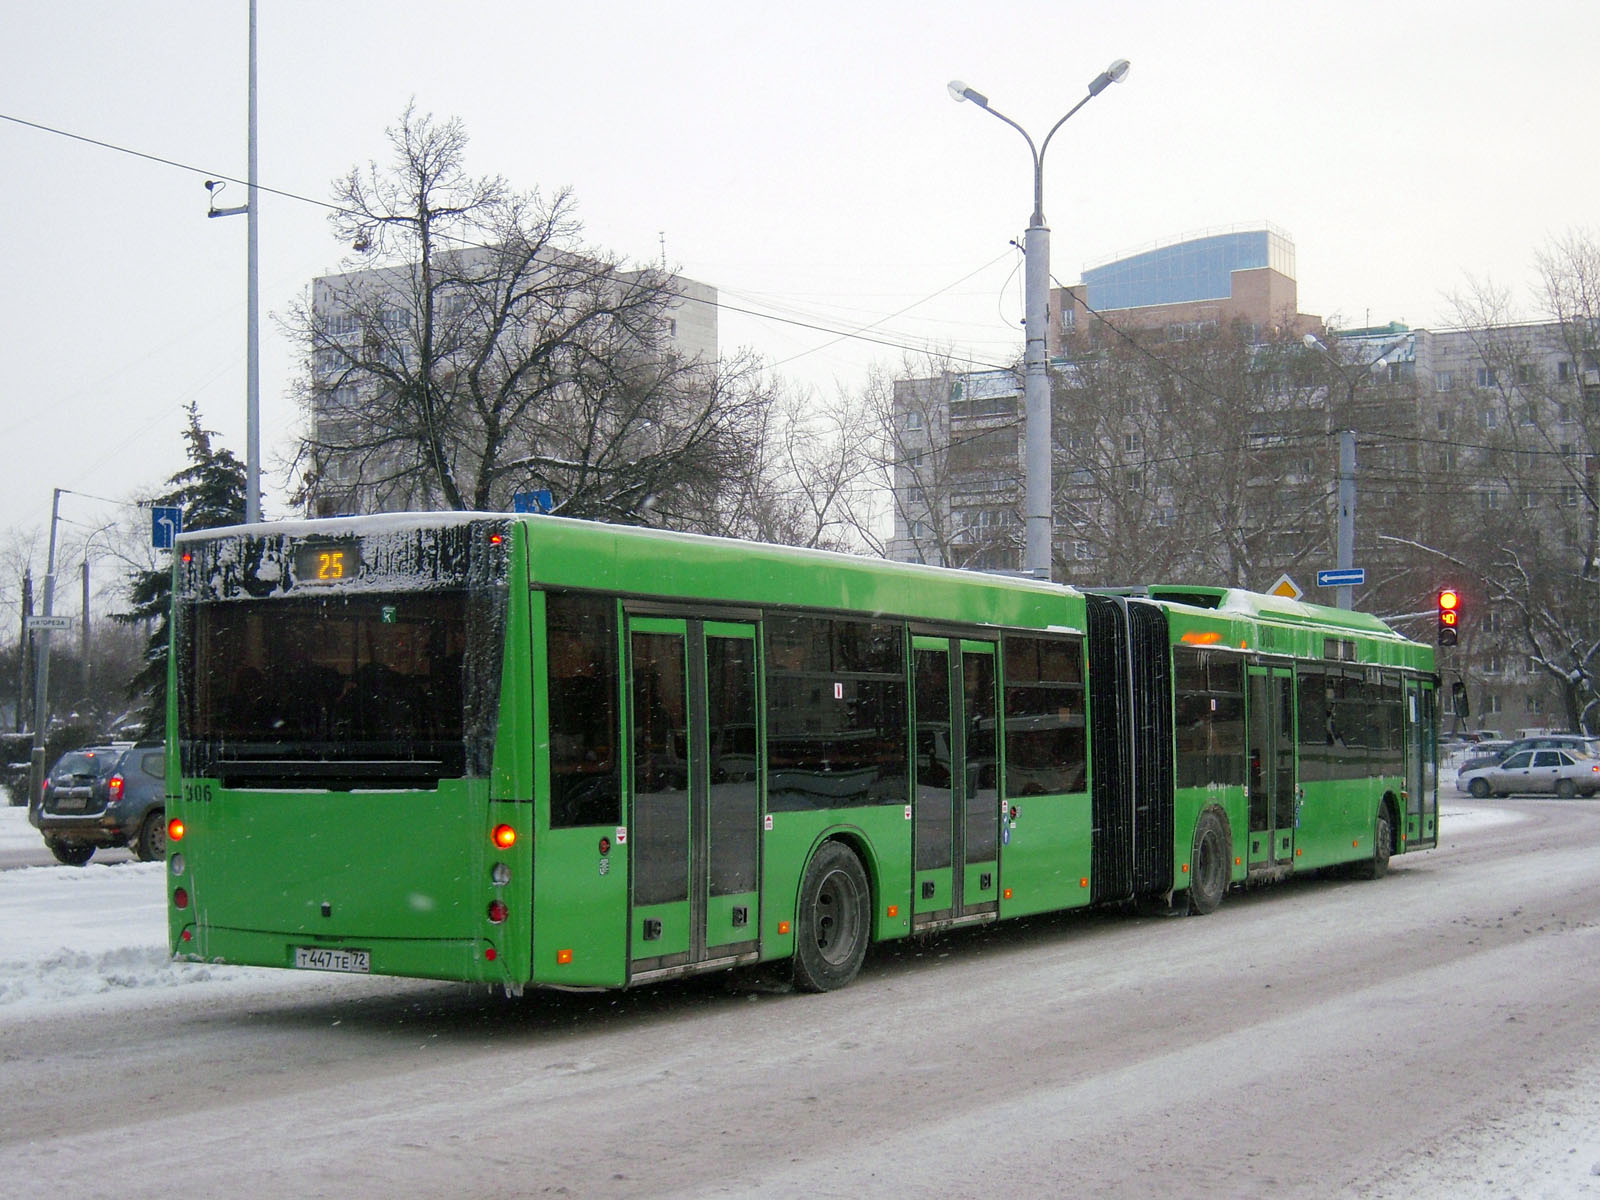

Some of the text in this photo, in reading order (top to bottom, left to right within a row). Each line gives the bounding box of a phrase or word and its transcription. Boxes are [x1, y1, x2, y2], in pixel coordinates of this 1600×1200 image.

[319, 553, 343, 579] 25
[1442, 613, 1455, 624] 40
[185, 783, 212, 801] 306
